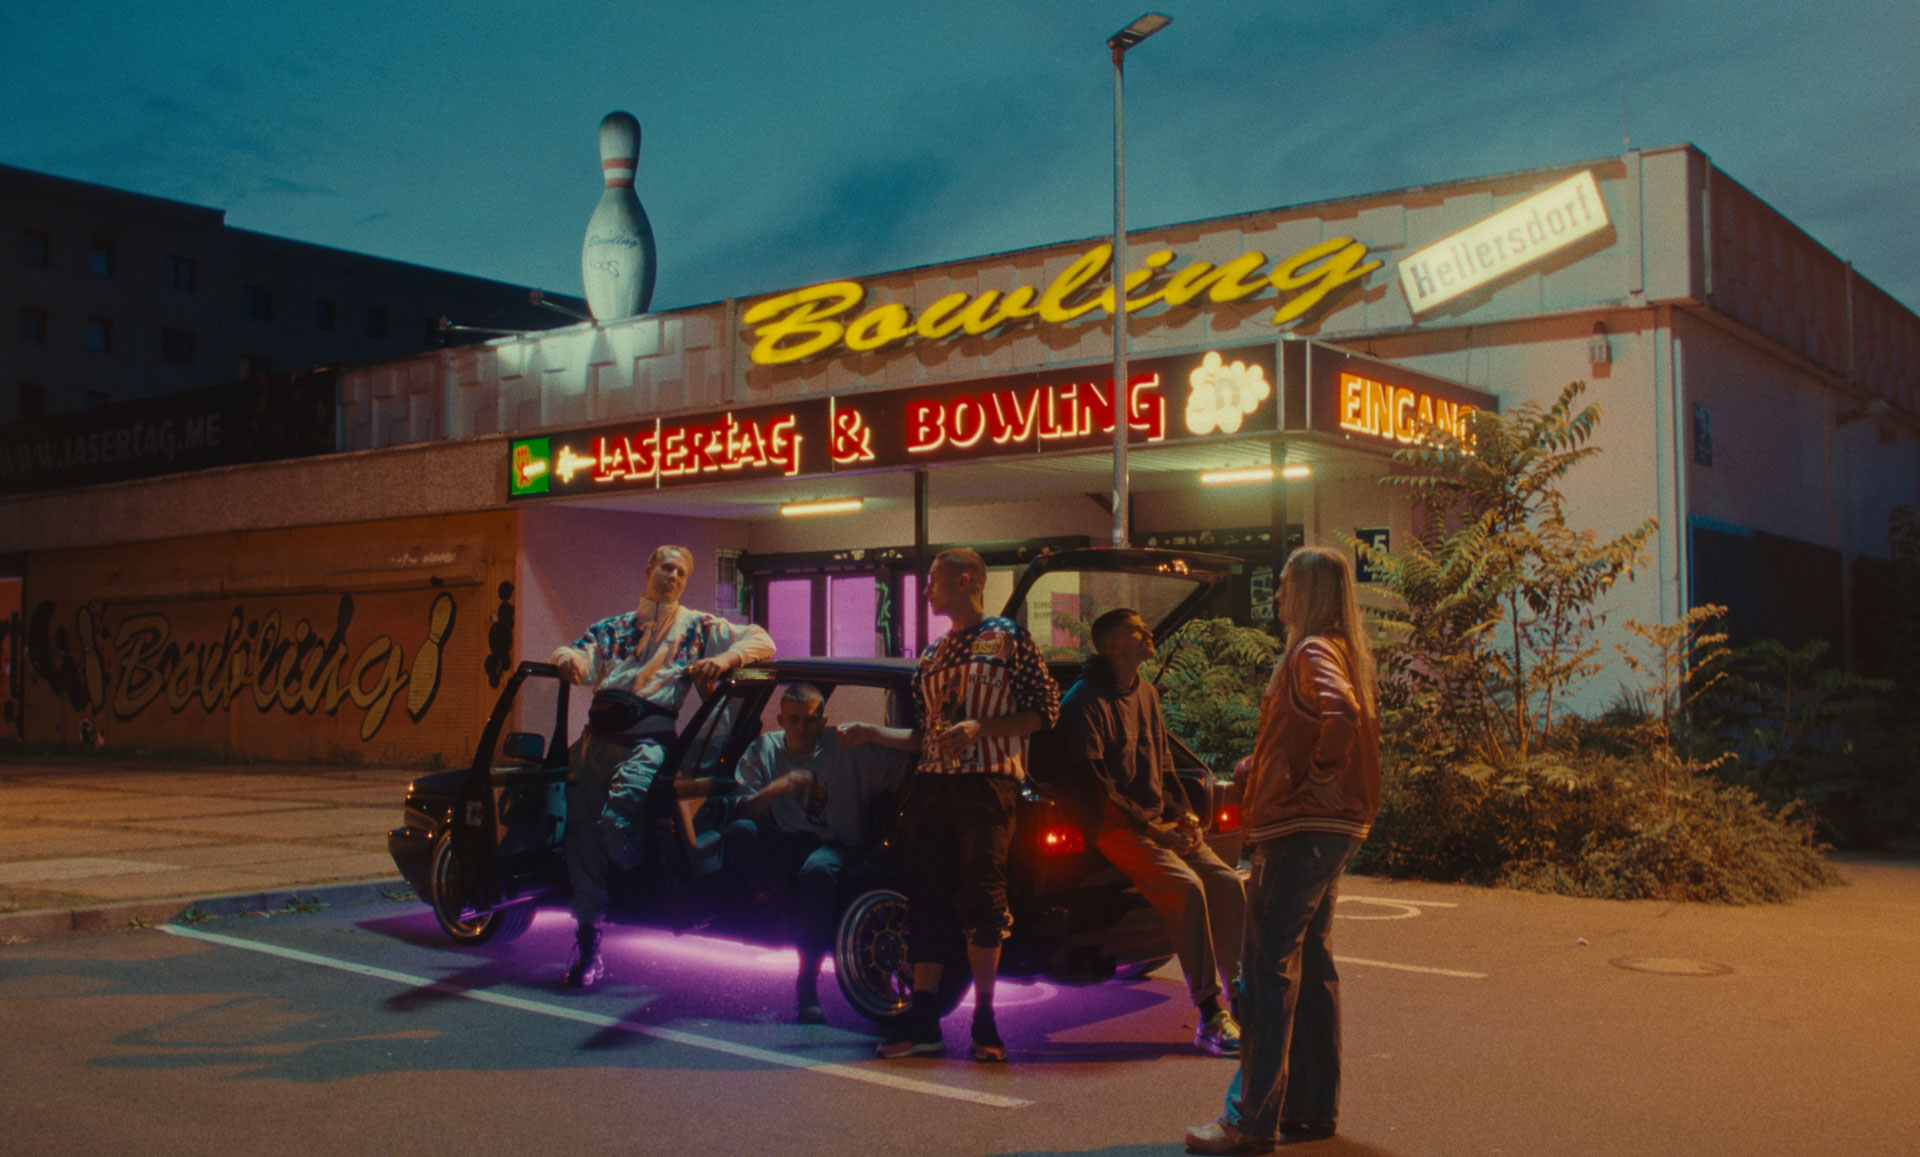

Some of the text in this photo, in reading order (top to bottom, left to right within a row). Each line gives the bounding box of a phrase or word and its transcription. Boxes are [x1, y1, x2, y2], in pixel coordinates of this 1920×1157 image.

[1410, 185, 1593, 298] Hellersdorf
[741, 236, 1384, 367] Bowling
[829, 407, 876, 464] &
[968, 673, 1002, 689] HELLO
